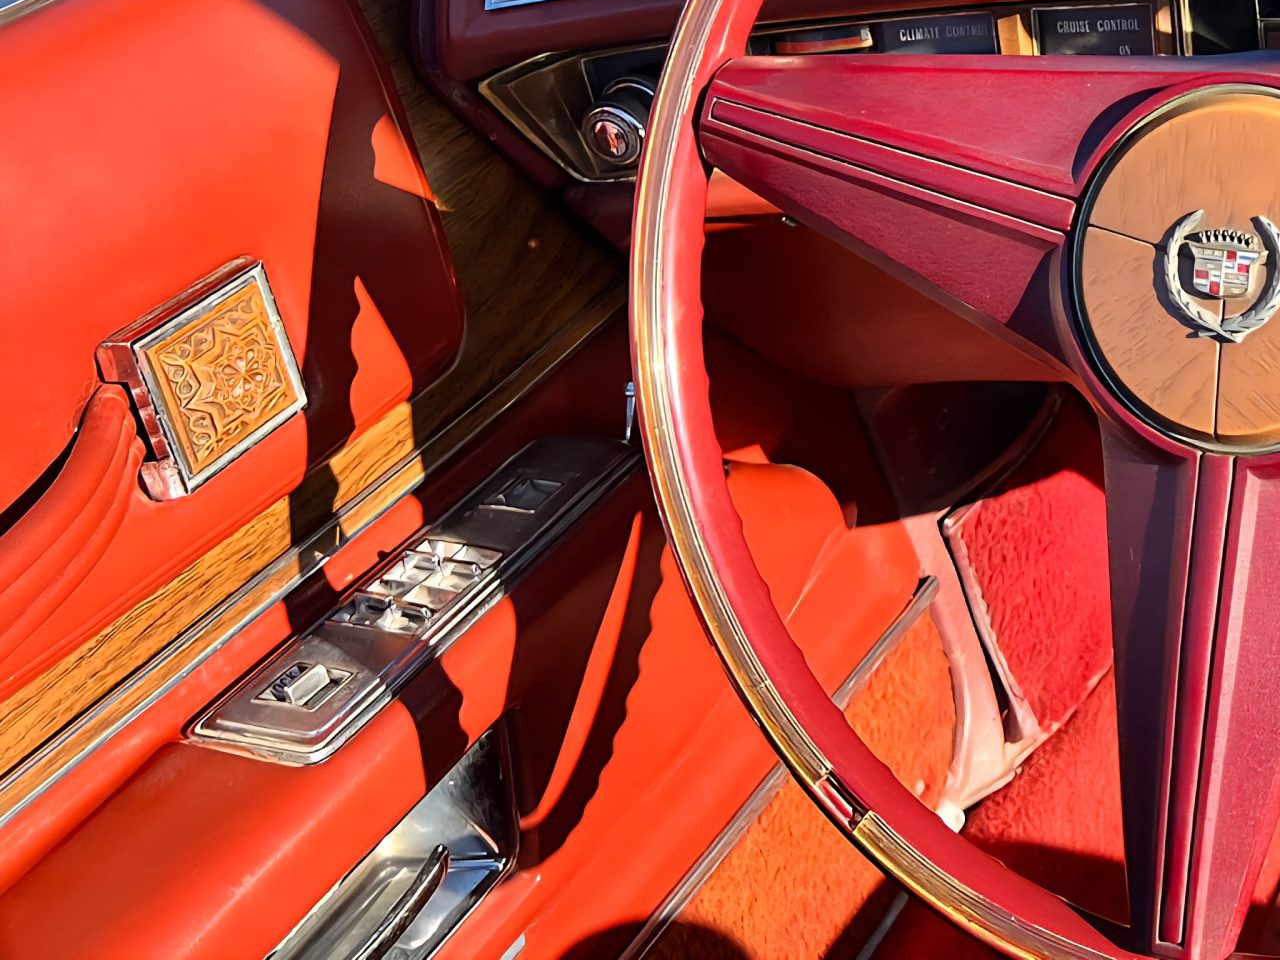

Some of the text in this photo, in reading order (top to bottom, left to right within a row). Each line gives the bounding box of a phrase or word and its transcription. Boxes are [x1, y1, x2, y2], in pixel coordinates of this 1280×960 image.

[1056, 17, 1140, 33] CRUISE CONTROL
[899, 26, 939, 42] CLIMATE
